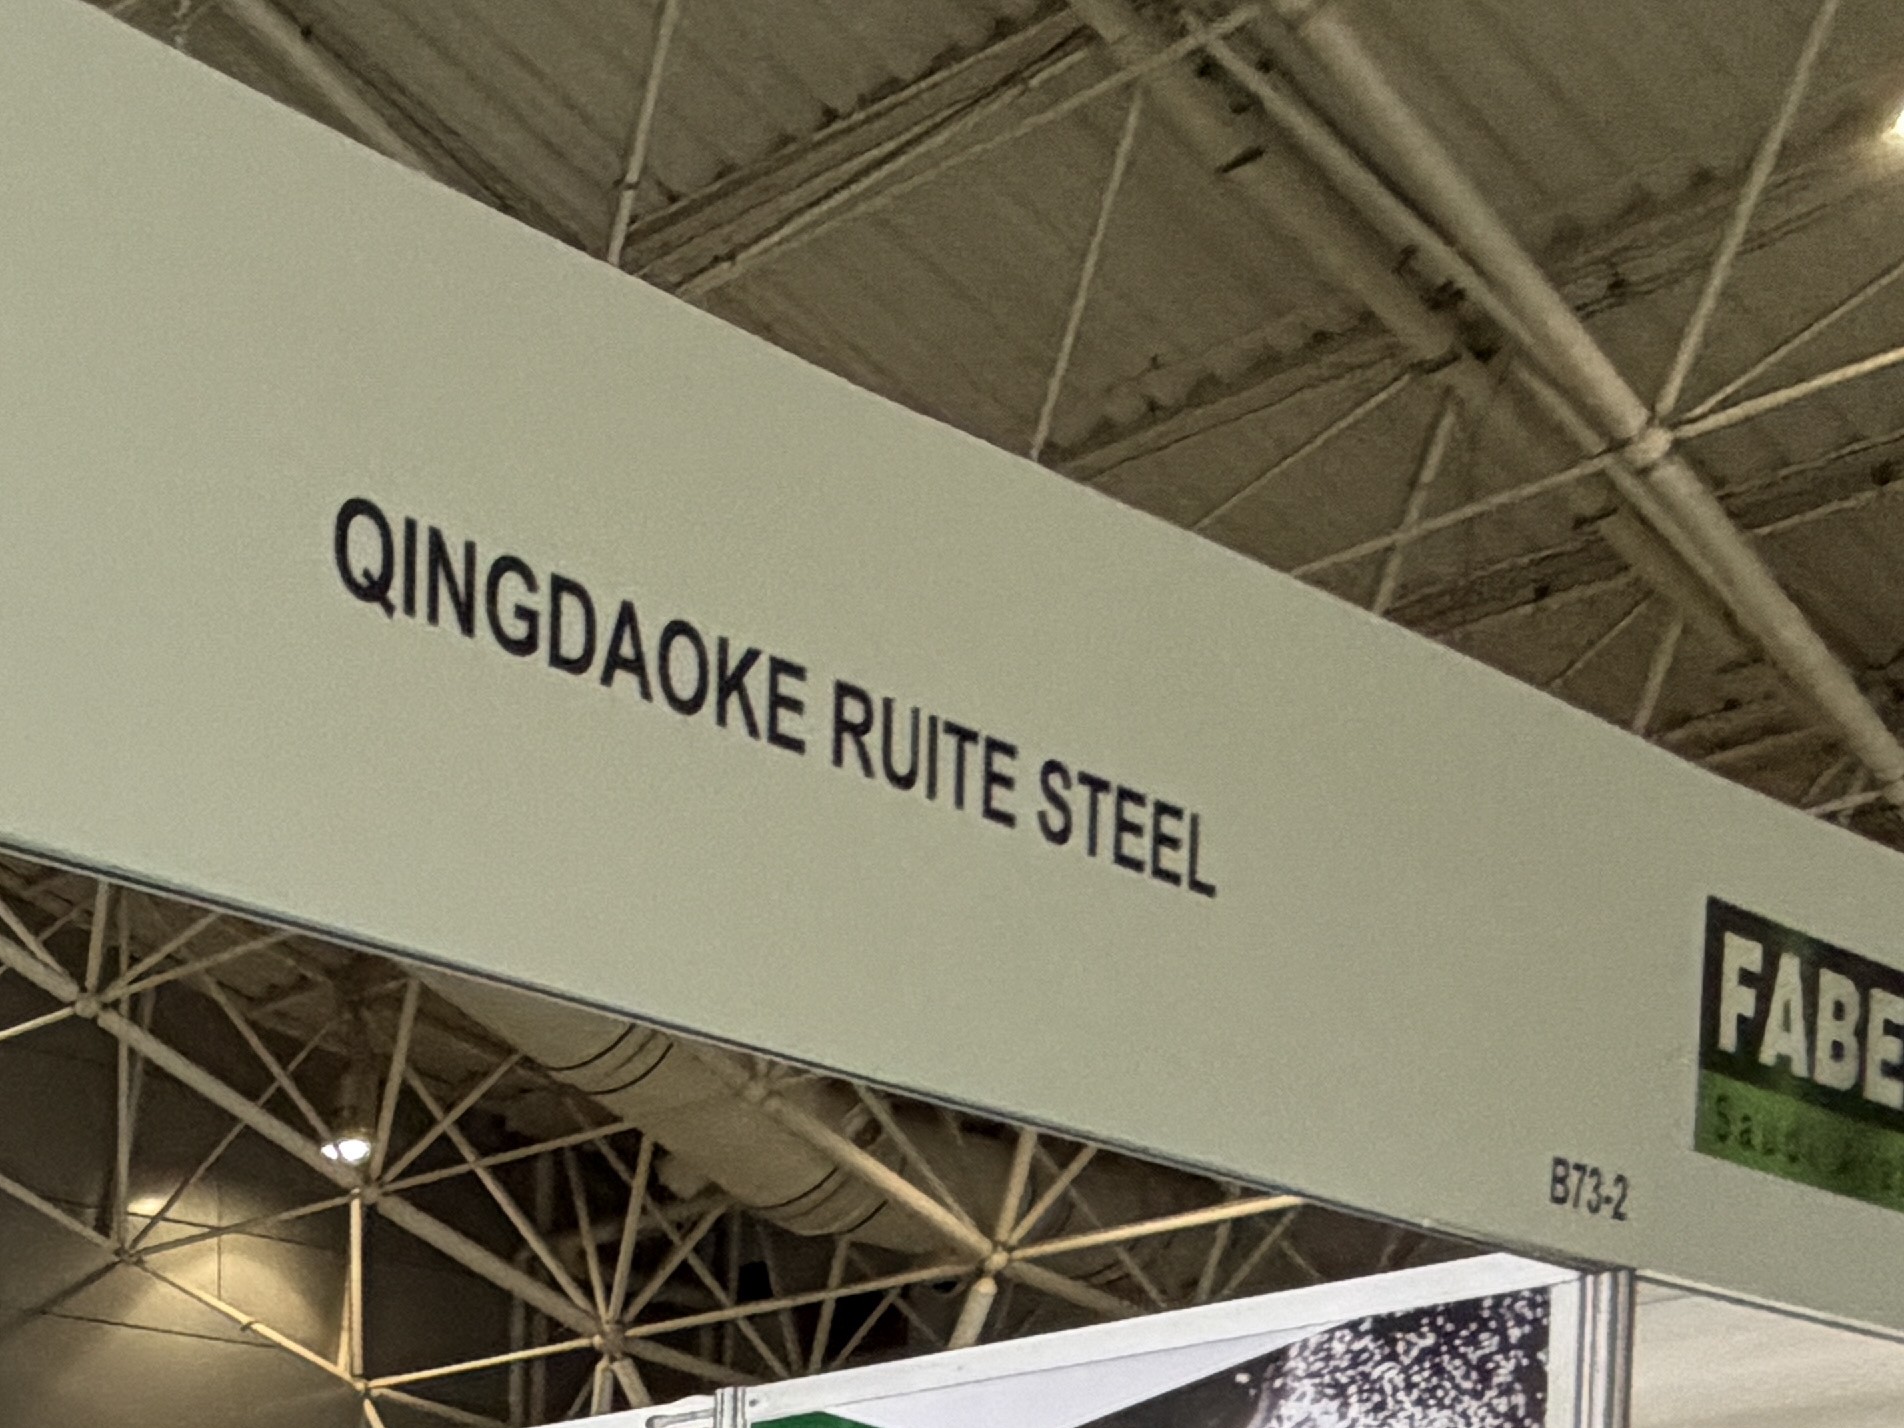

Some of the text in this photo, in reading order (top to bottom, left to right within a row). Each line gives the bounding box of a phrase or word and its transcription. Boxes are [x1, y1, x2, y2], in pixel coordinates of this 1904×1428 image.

[332, 496, 1218, 896] QINGDAOKE RUITE STEEL
[1550, 1156, 1629, 1221] B73-2
